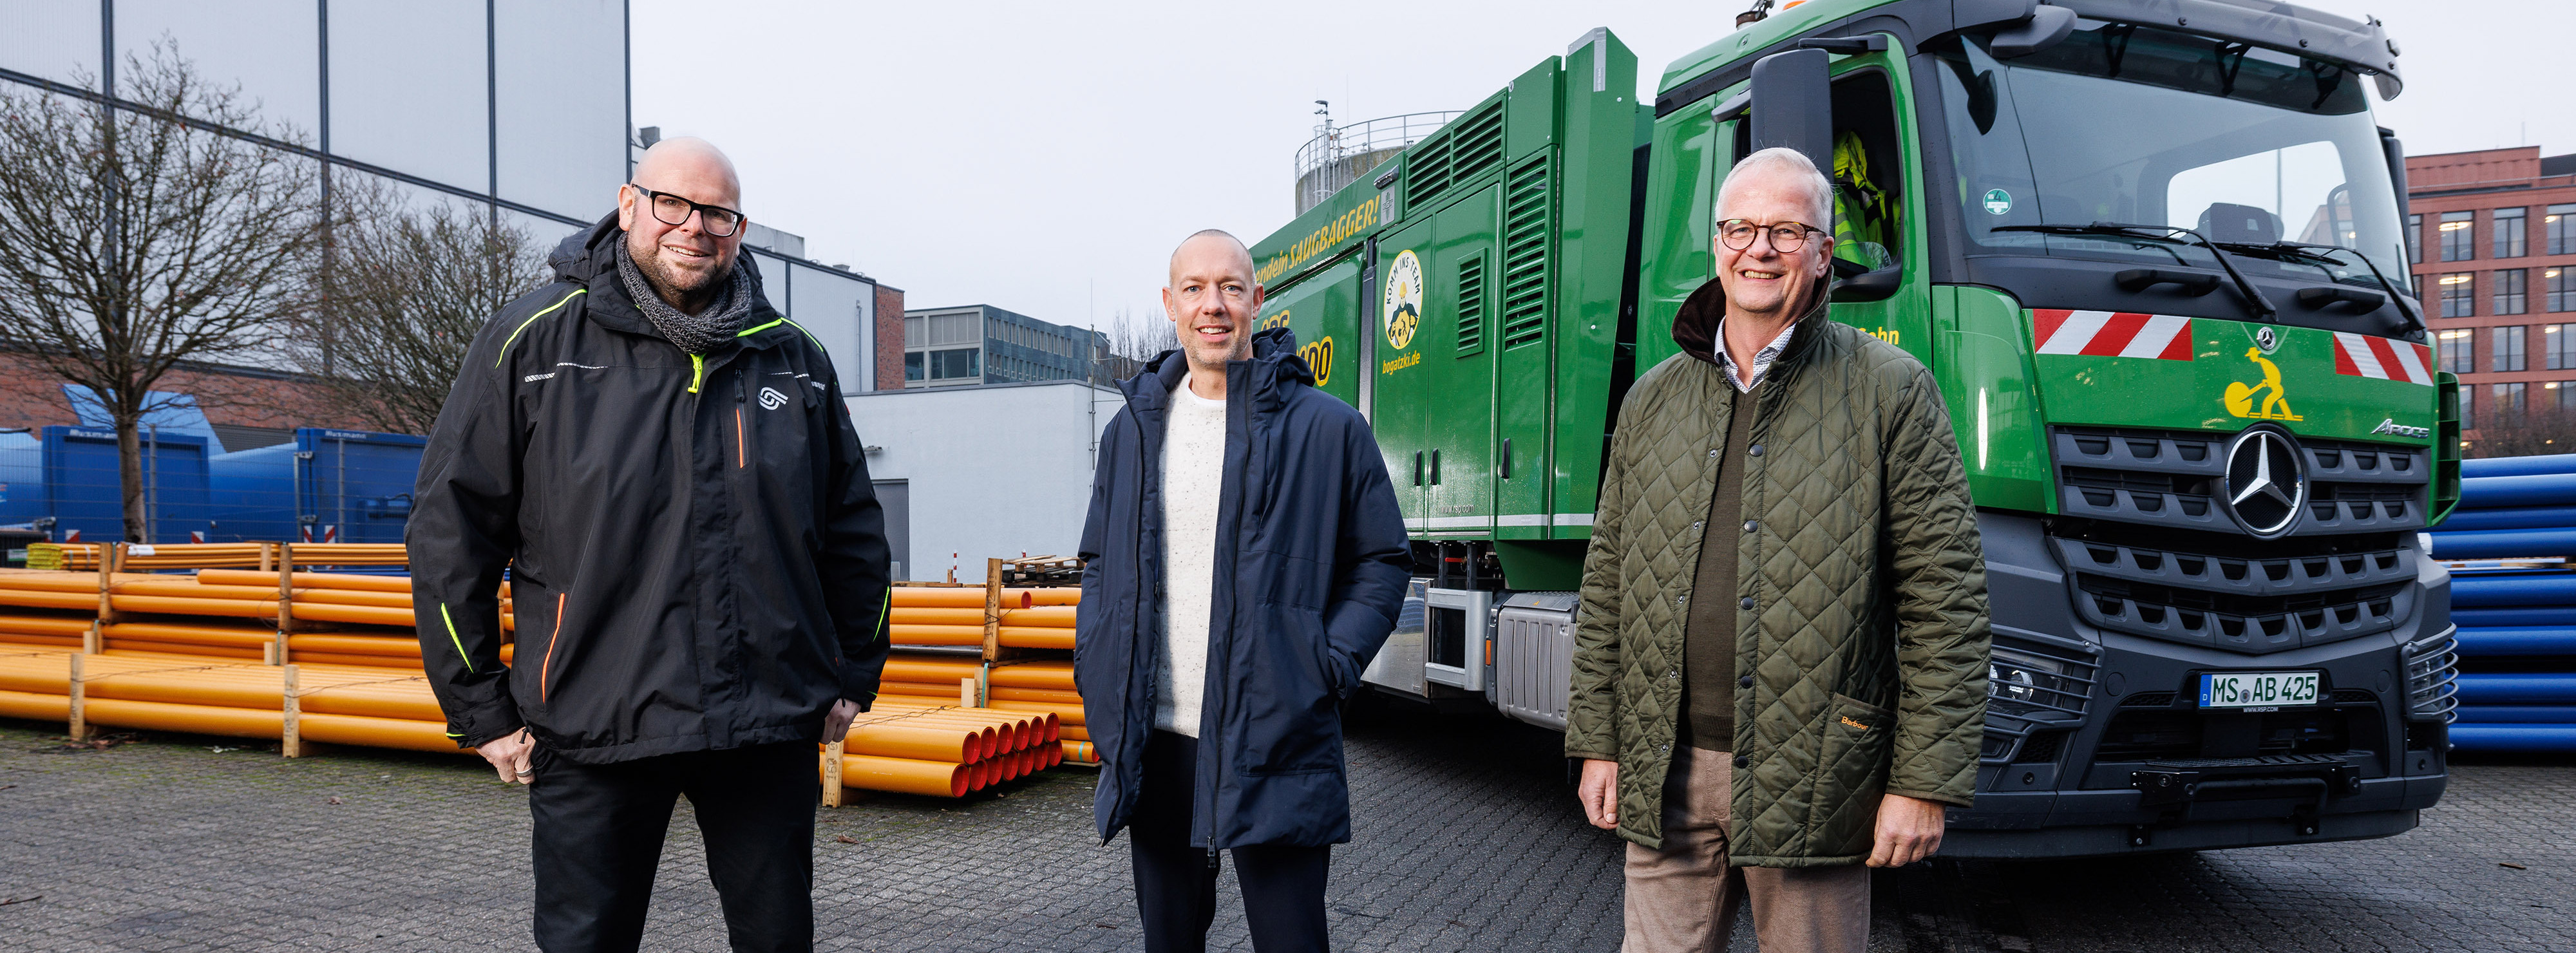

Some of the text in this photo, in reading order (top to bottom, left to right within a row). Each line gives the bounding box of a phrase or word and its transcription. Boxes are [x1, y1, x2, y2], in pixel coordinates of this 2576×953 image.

[1994, 190, 2002, 202] 4
[1255, 194, 1380, 285] endein SAUGBAGGER!
[1387, 256, 1421, 305] KOMM INS TEAM
[1859, 326, 1899, 344] hn
[1382, 350, 1421, 375] bogatzki.de
[1440, 504, 1475, 515] www.rsp.com
[2202, 693, 2208, 701] D
[2213, 676, 2316, 703] MS AB 425
[1841, 716, 1869, 730] Barbour
